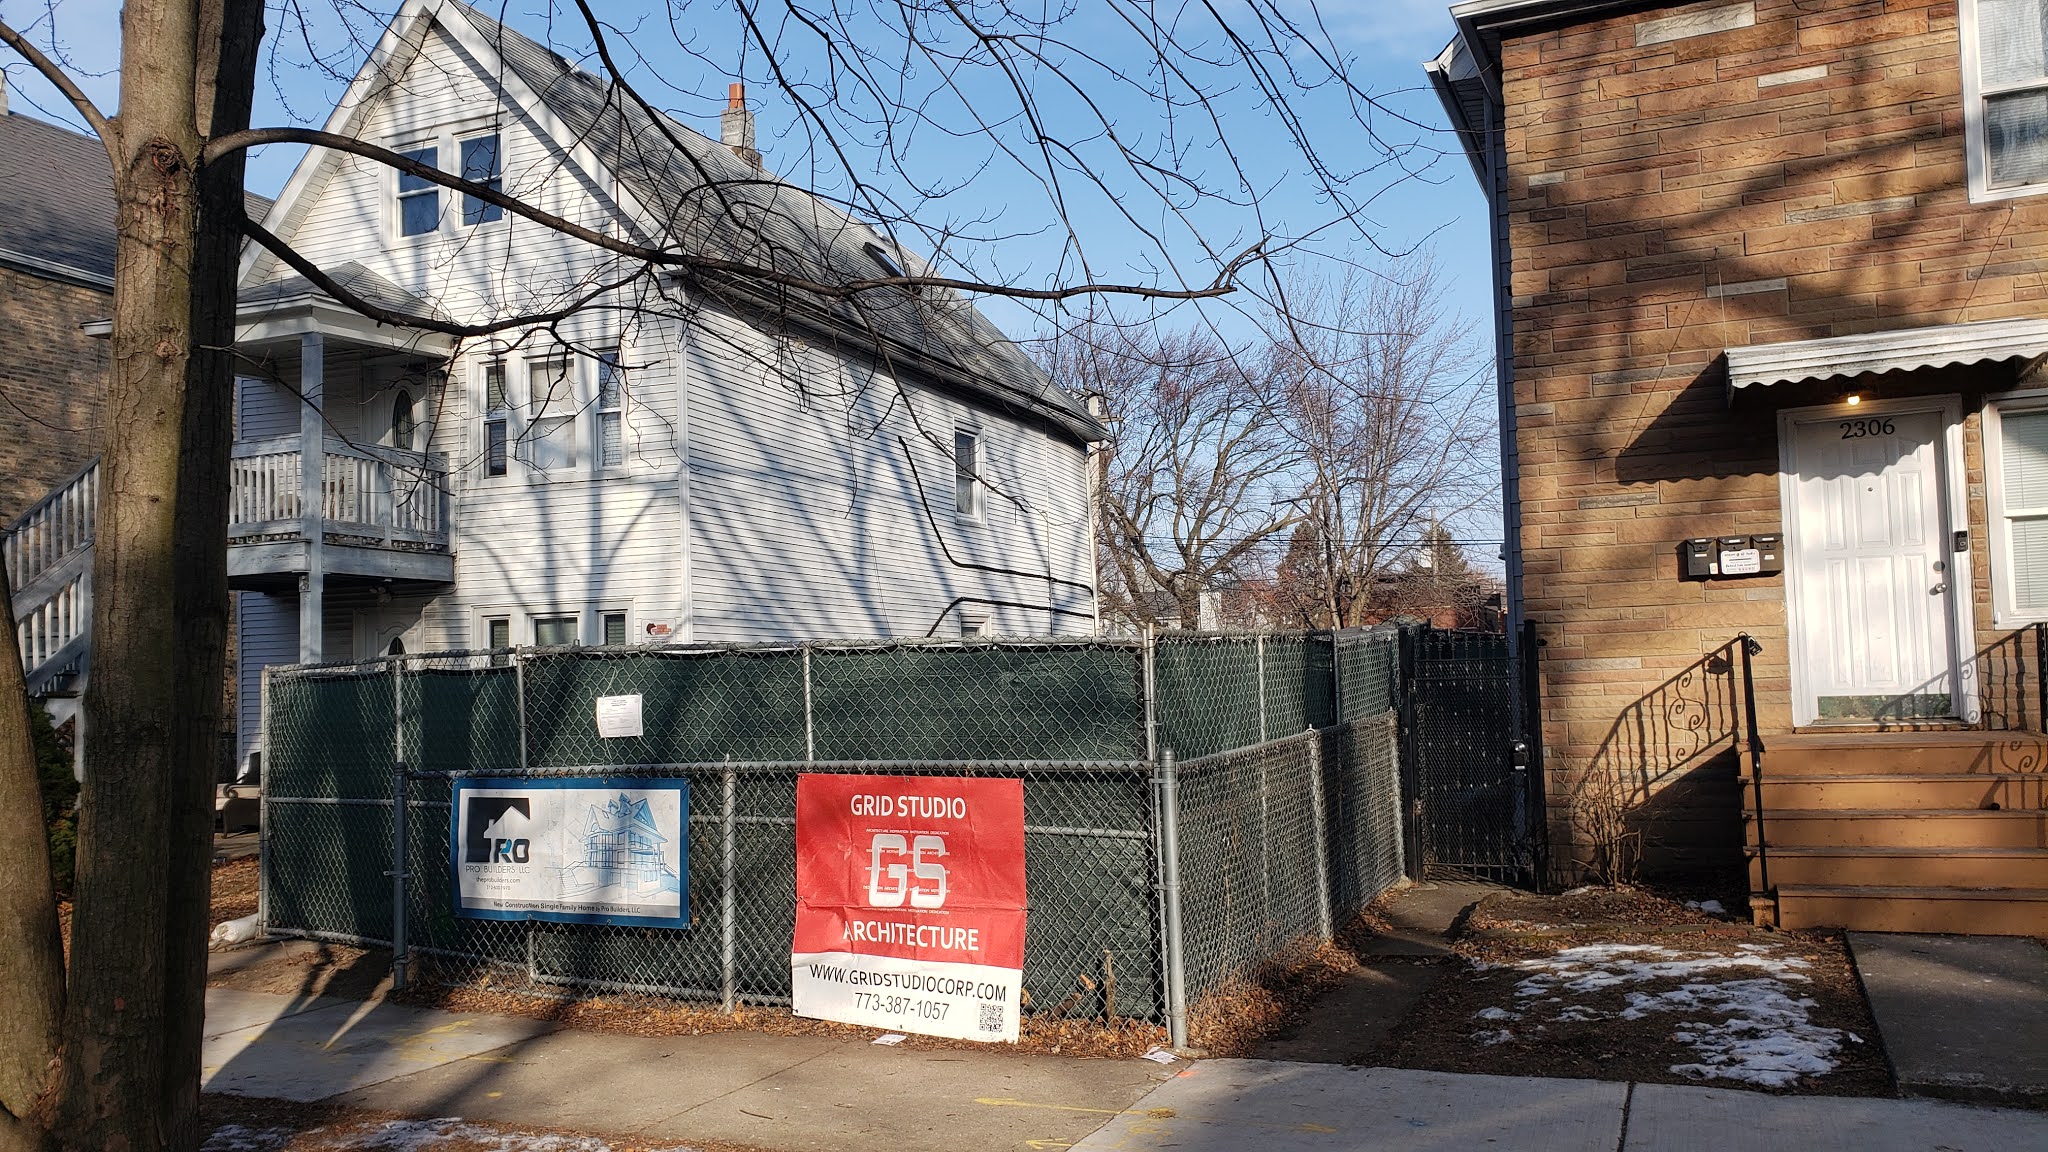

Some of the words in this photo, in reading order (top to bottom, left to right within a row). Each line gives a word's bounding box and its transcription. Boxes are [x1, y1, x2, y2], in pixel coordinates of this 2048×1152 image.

[1839, 418, 1896, 440] 2306
[850, 794, 893, 817] GRID
[897, 796, 966, 819] STUDIO
[465, 864, 481, 873] PRO
[483, 865, 516, 874] BUILDERS
[519, 866, 530, 874] LLC
[869, 834, 946, 908] GS
[540, 903, 559, 911] Single
[560, 904, 577, 912] Family
[843, 920, 979, 951] ARCHITECTURE
[809, 963, 1006, 1002] WWW.GRIDSTUDIOCORP.COM
[854, 992, 949, 1021] 773-387-1057
